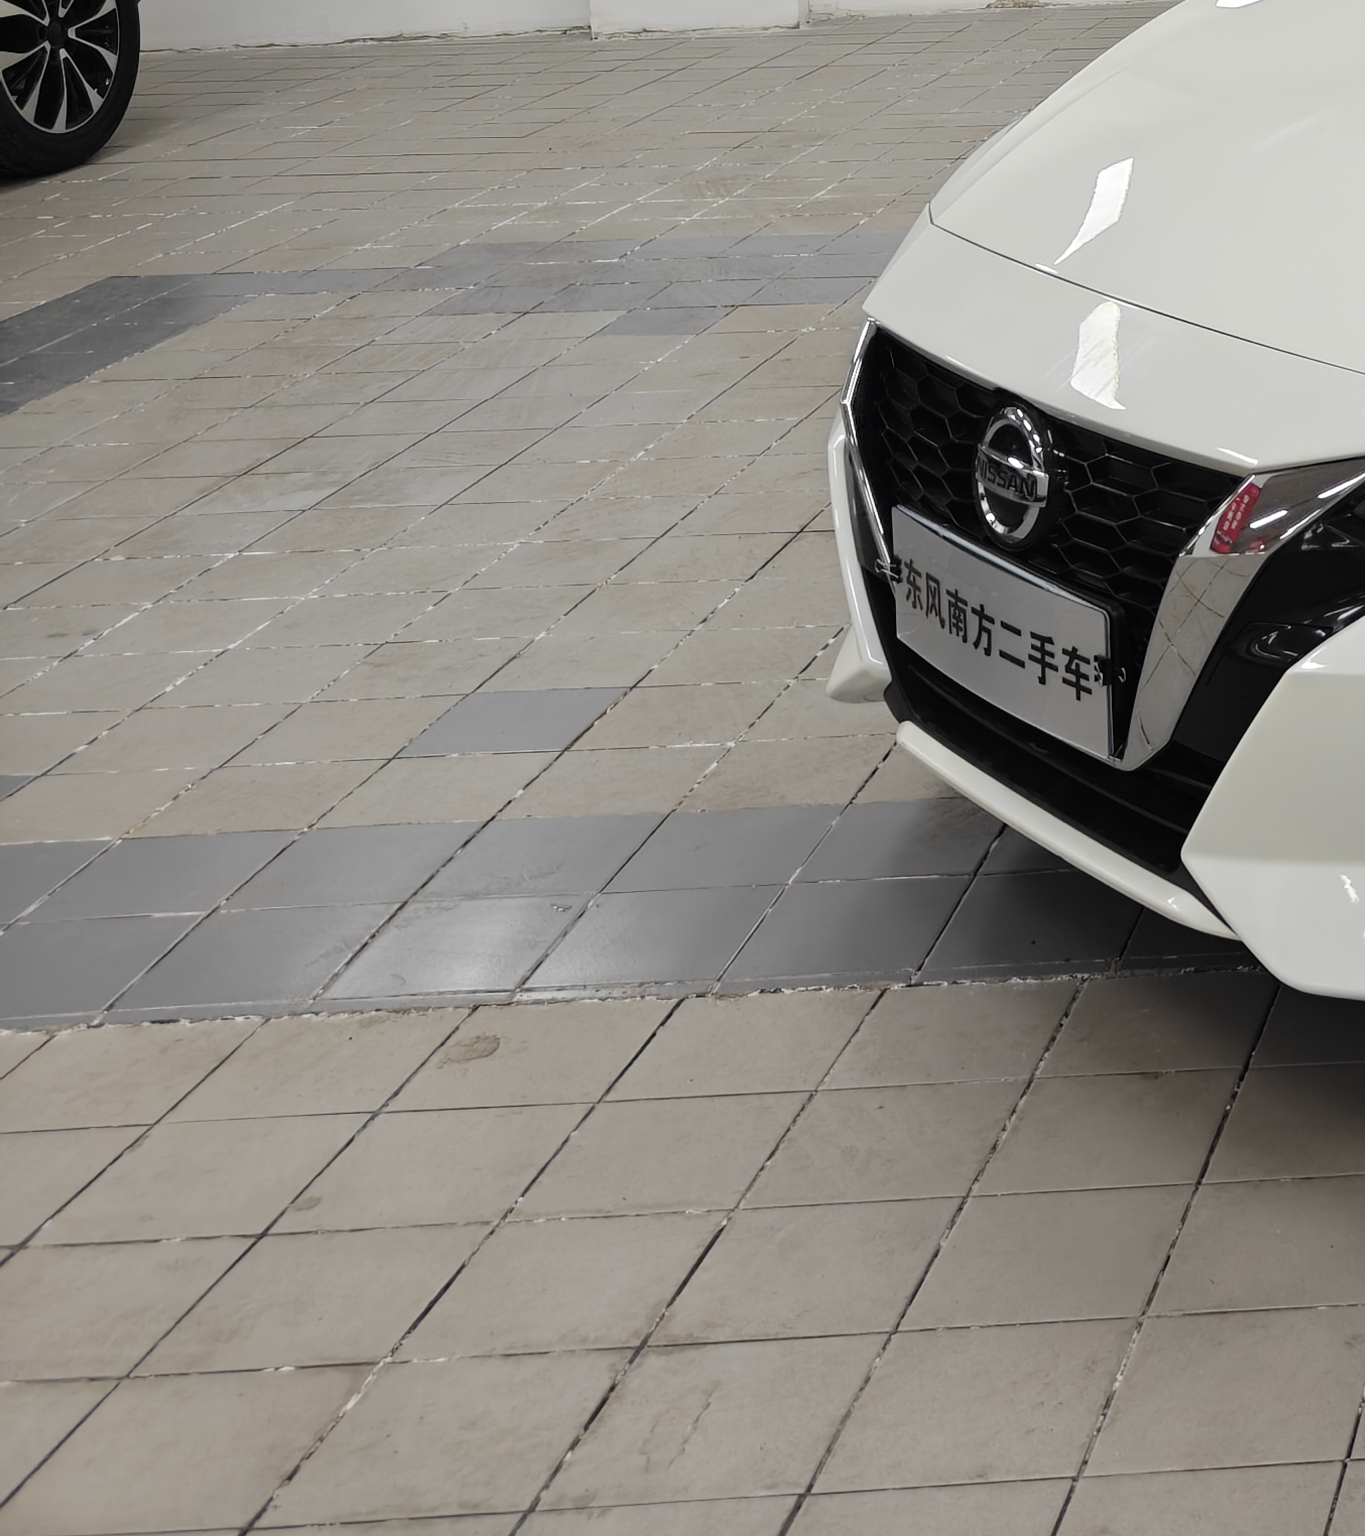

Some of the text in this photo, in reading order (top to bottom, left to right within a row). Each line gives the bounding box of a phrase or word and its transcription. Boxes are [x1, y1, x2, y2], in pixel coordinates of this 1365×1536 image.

[981, 455, 1037, 500] NISSAN
[904, 558, 1092, 701] 东风南方二手车
